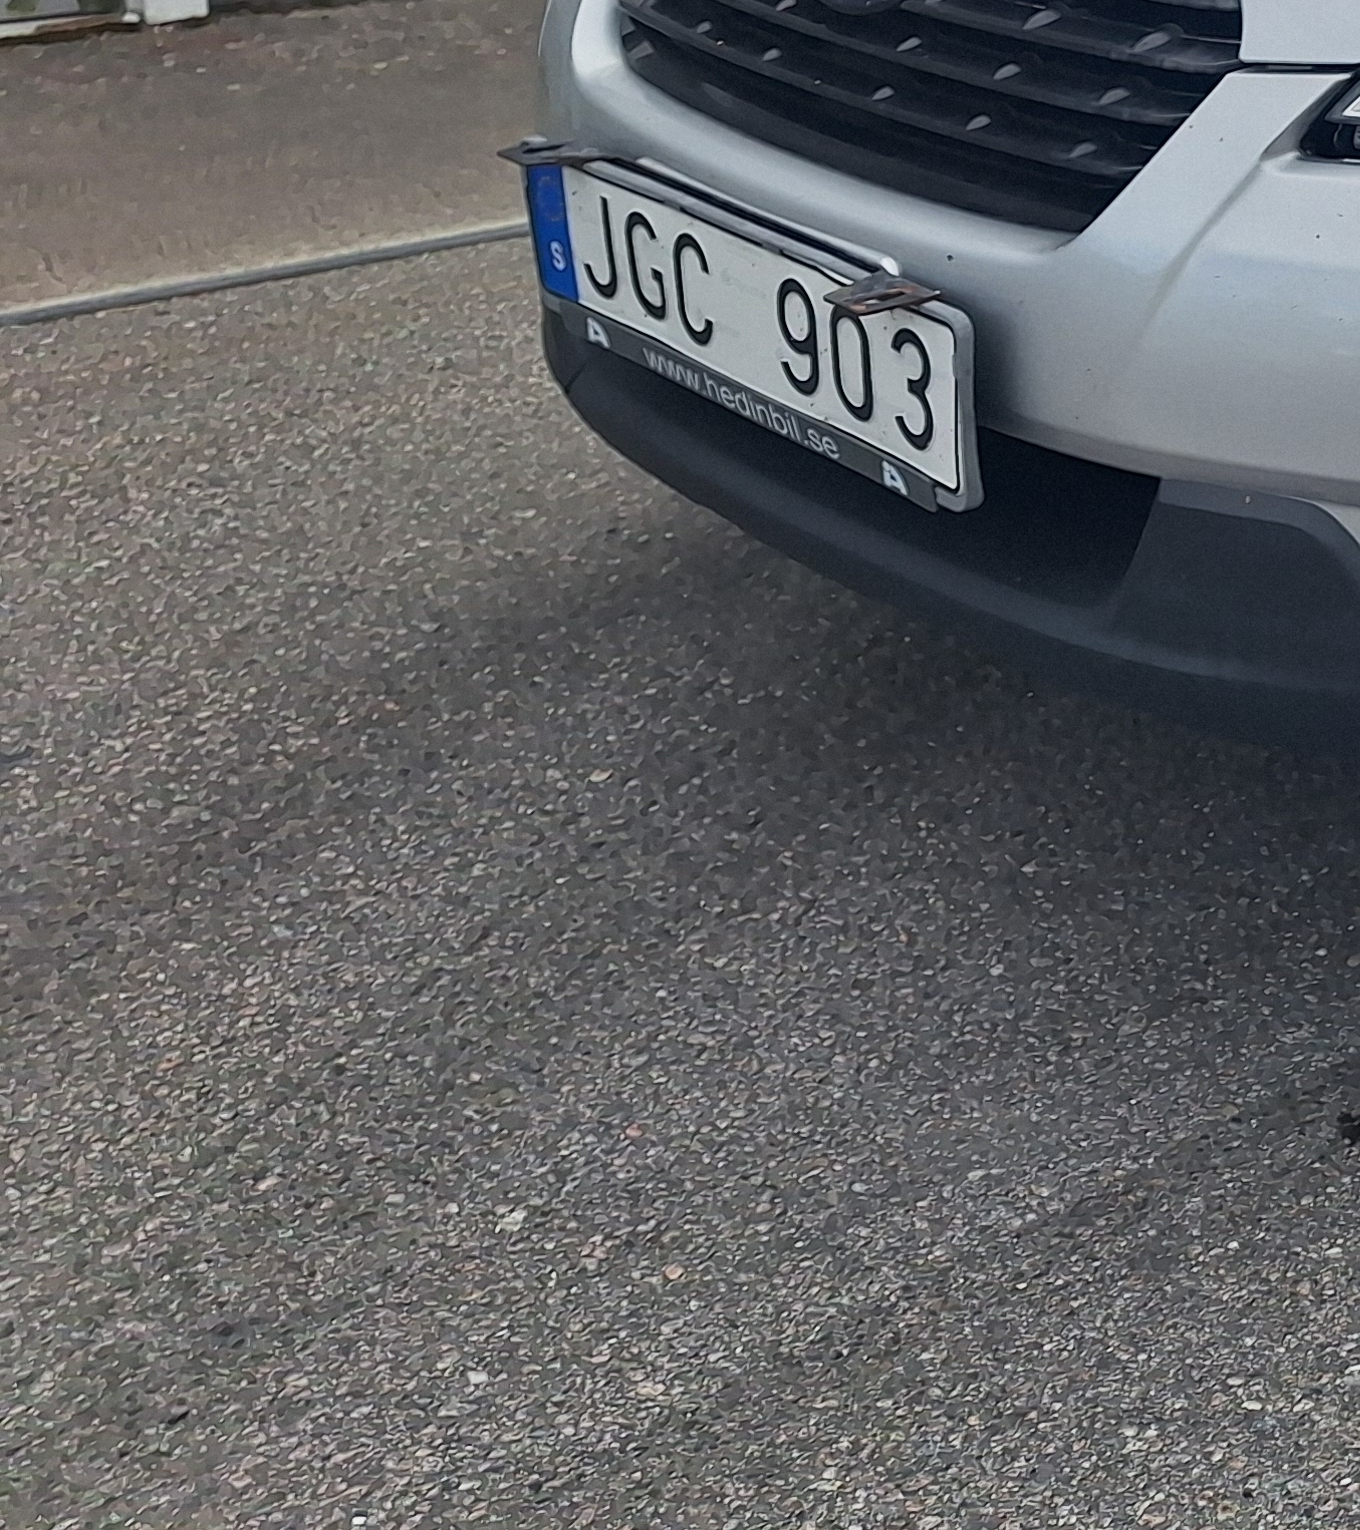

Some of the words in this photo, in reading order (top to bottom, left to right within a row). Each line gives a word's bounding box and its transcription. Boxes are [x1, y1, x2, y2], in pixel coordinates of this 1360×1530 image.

[550, 240, 567, 271] S
[583, 196, 713, 346] JGC
[776, 278, 935, 451] 903
[642, 347, 841, 460] www.hedinbil.se
